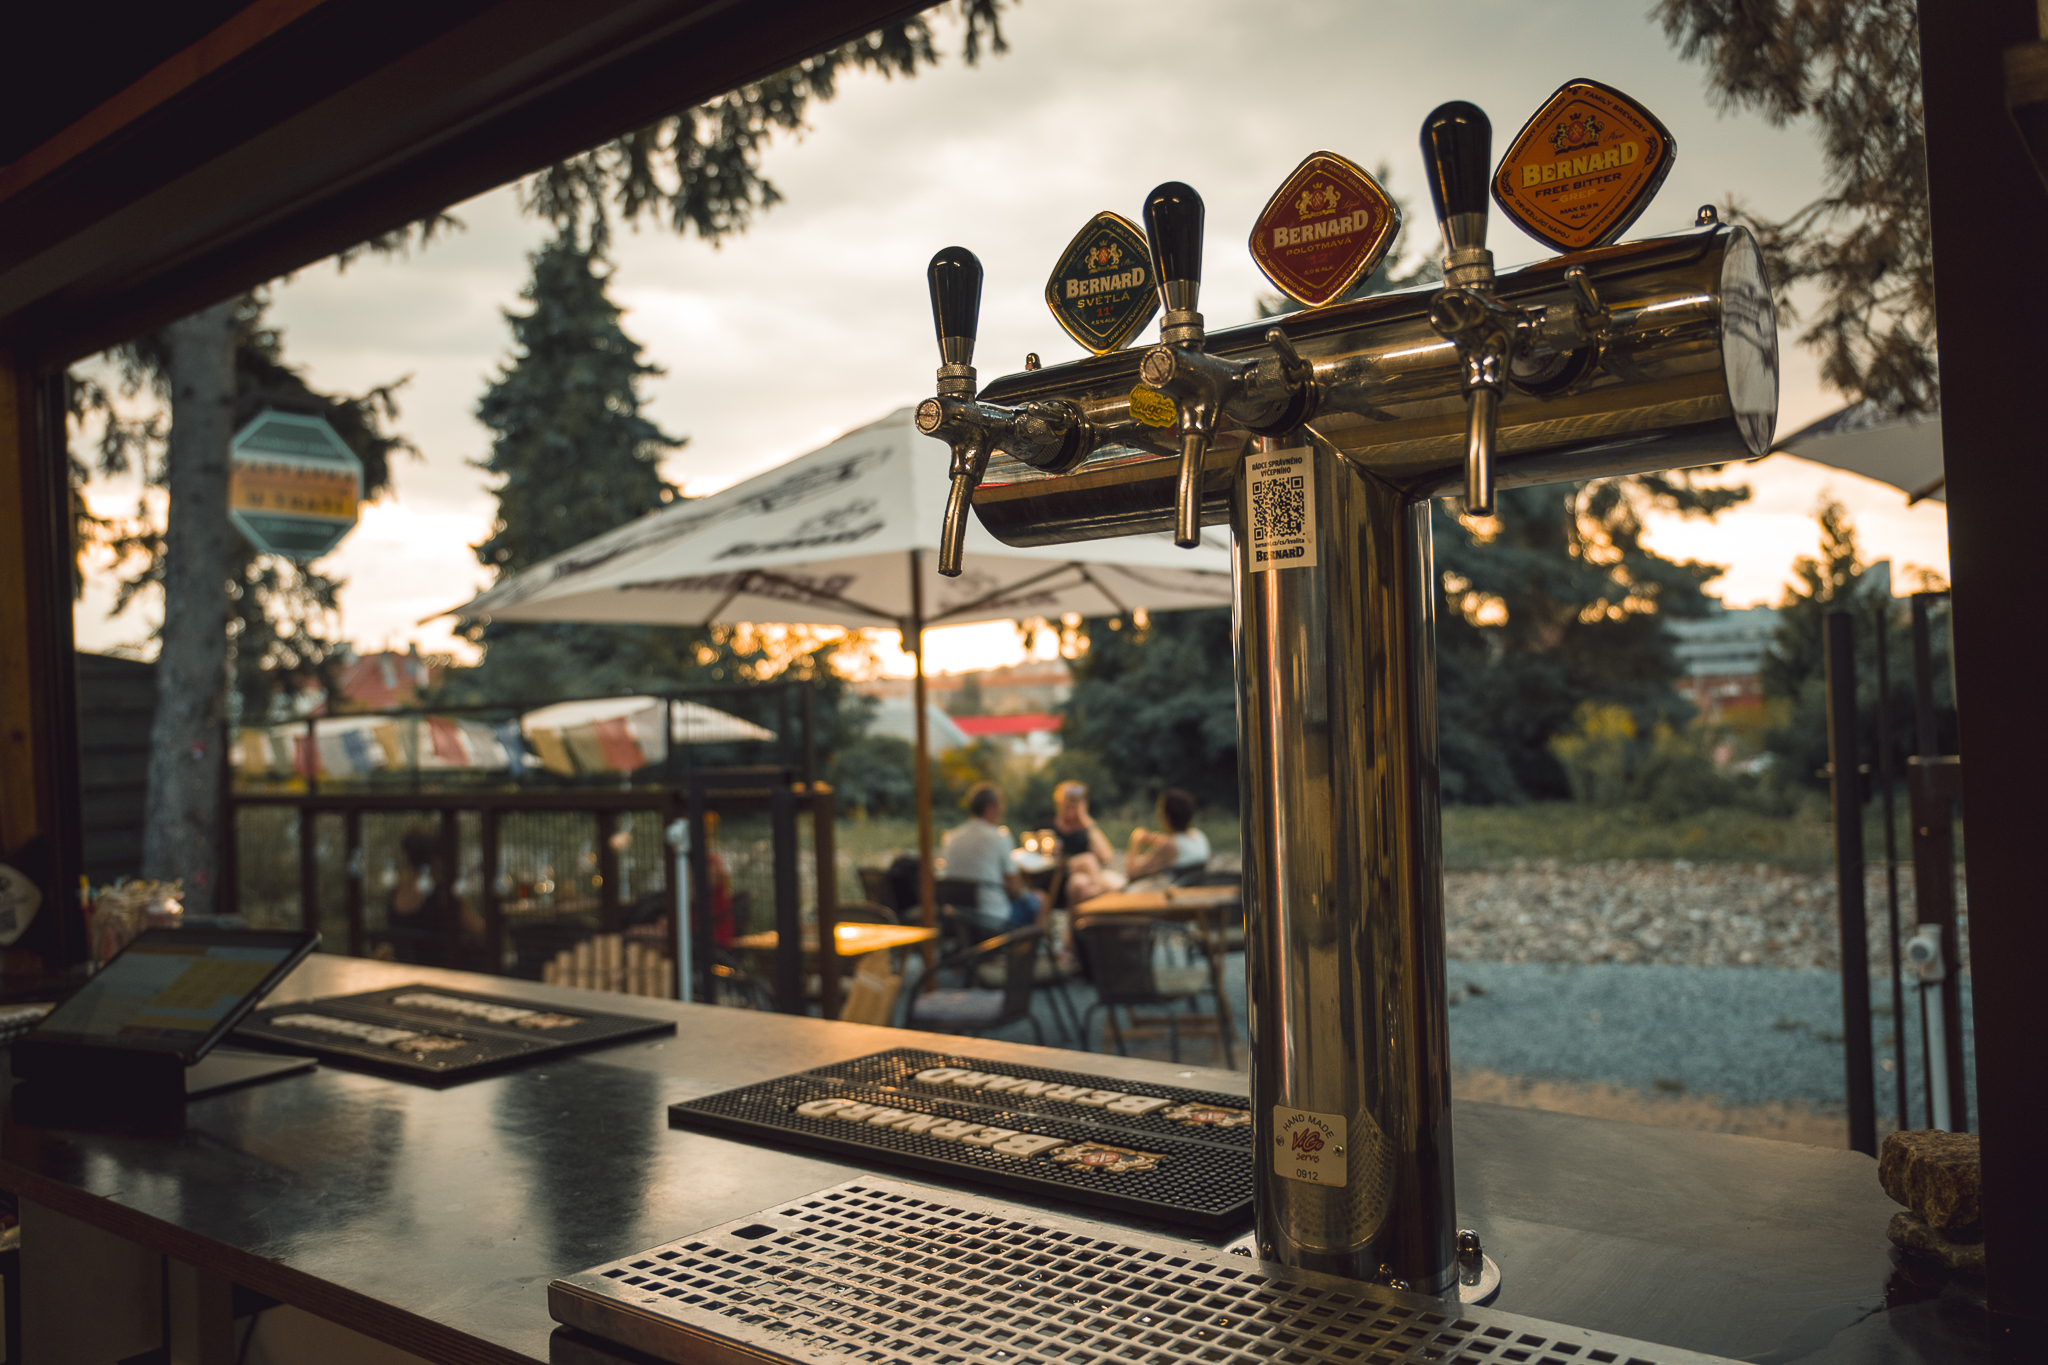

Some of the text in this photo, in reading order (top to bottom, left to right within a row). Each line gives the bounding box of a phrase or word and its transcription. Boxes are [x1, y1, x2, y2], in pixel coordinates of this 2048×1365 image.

[1536, 97, 1566, 129] PIVOVAR
[1584, 91, 1647, 133] FAMILY BREWERY
[1522, 141, 1639, 188] BERNARD
[1285, 169, 1310, 196] PIVOVAR
[1324, 164, 1376, 204] FAMILY BREWERY
[1535, 172, 1622, 198] FREE BITTER
[1560, 189, 1596, 203] GREP
[1560, 206, 1578, 215] MAX
[1588, 172, 1644, 235] REFRESHING DRINK
[1273, 209, 1369, 249] BERNARD
[1547, 224, 1571, 240] NÁPOJ
[1110, 223, 1150, 263] FAMILY BREWERY
[1325, 237, 1373, 294] UNPASTEURIZED
[1065, 267, 1145, 299] BERNARD
[1077, 290, 1130, 309] SVĚTLÁ
[1097, 306, 1115, 317] 11°
[1108, 293, 1149, 343] UNPASTEURIZED
[1252, 457, 1303, 471] RÁDCE SPRÁVNÉHO
[1261, 466, 1291, 478] VÝČEPNÍHO
[1256, 546, 1305, 562] BERNARD
[915, 1068, 1175, 1115] BERNARD
[797, 1099, 1068, 1157] BERNARD
[1283, 1114, 1335, 1139] HAND MADE
[1296, 1152, 1320, 1163] servis
[1296, 1168, 1318, 1180] 0912
